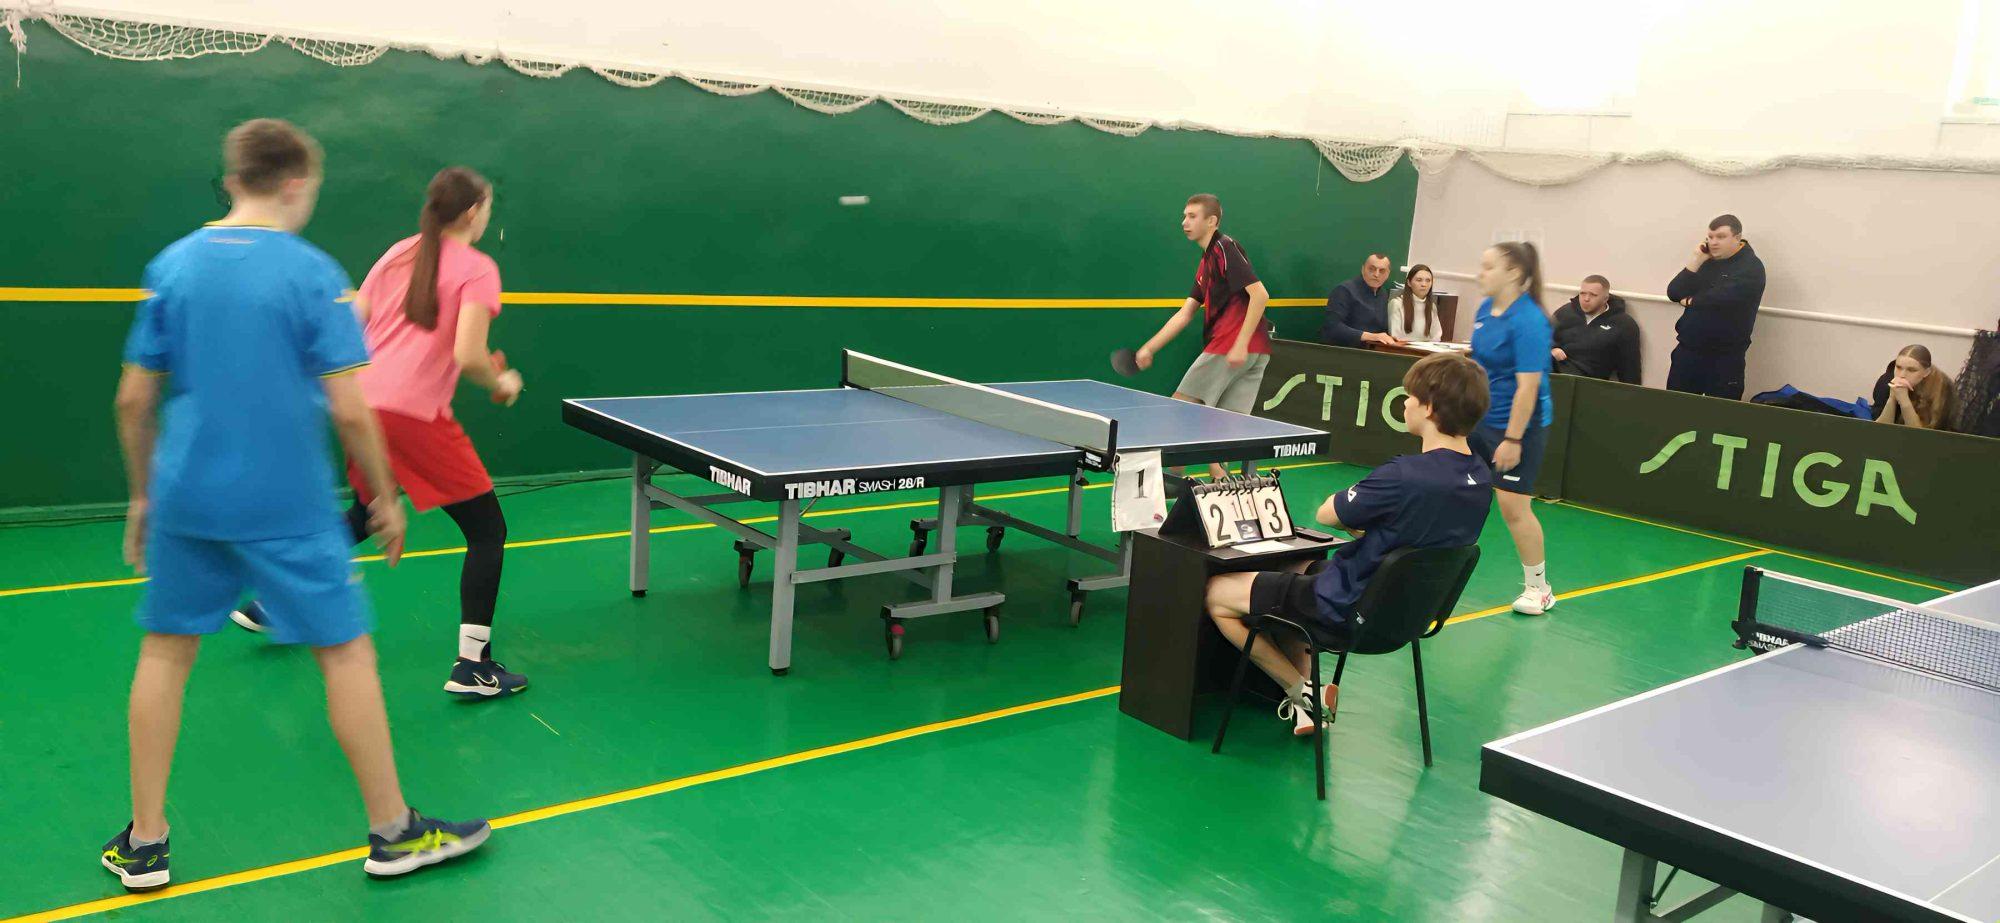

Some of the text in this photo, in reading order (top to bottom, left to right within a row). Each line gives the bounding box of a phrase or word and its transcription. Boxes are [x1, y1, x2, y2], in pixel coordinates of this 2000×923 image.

[1273, 442, 1316, 458] TIBHAR
[709, 465, 751, 496] TIBHAR
[784, 478, 856, 500] TIBHAR
[858, 481, 896, 493] SMASH
[1133, 468, 1148, 499] 1
[1639, 430, 1917, 525] STIGA
[1209, 503, 1231, 541] 2
[1264, 498, 1283, 533] 3
